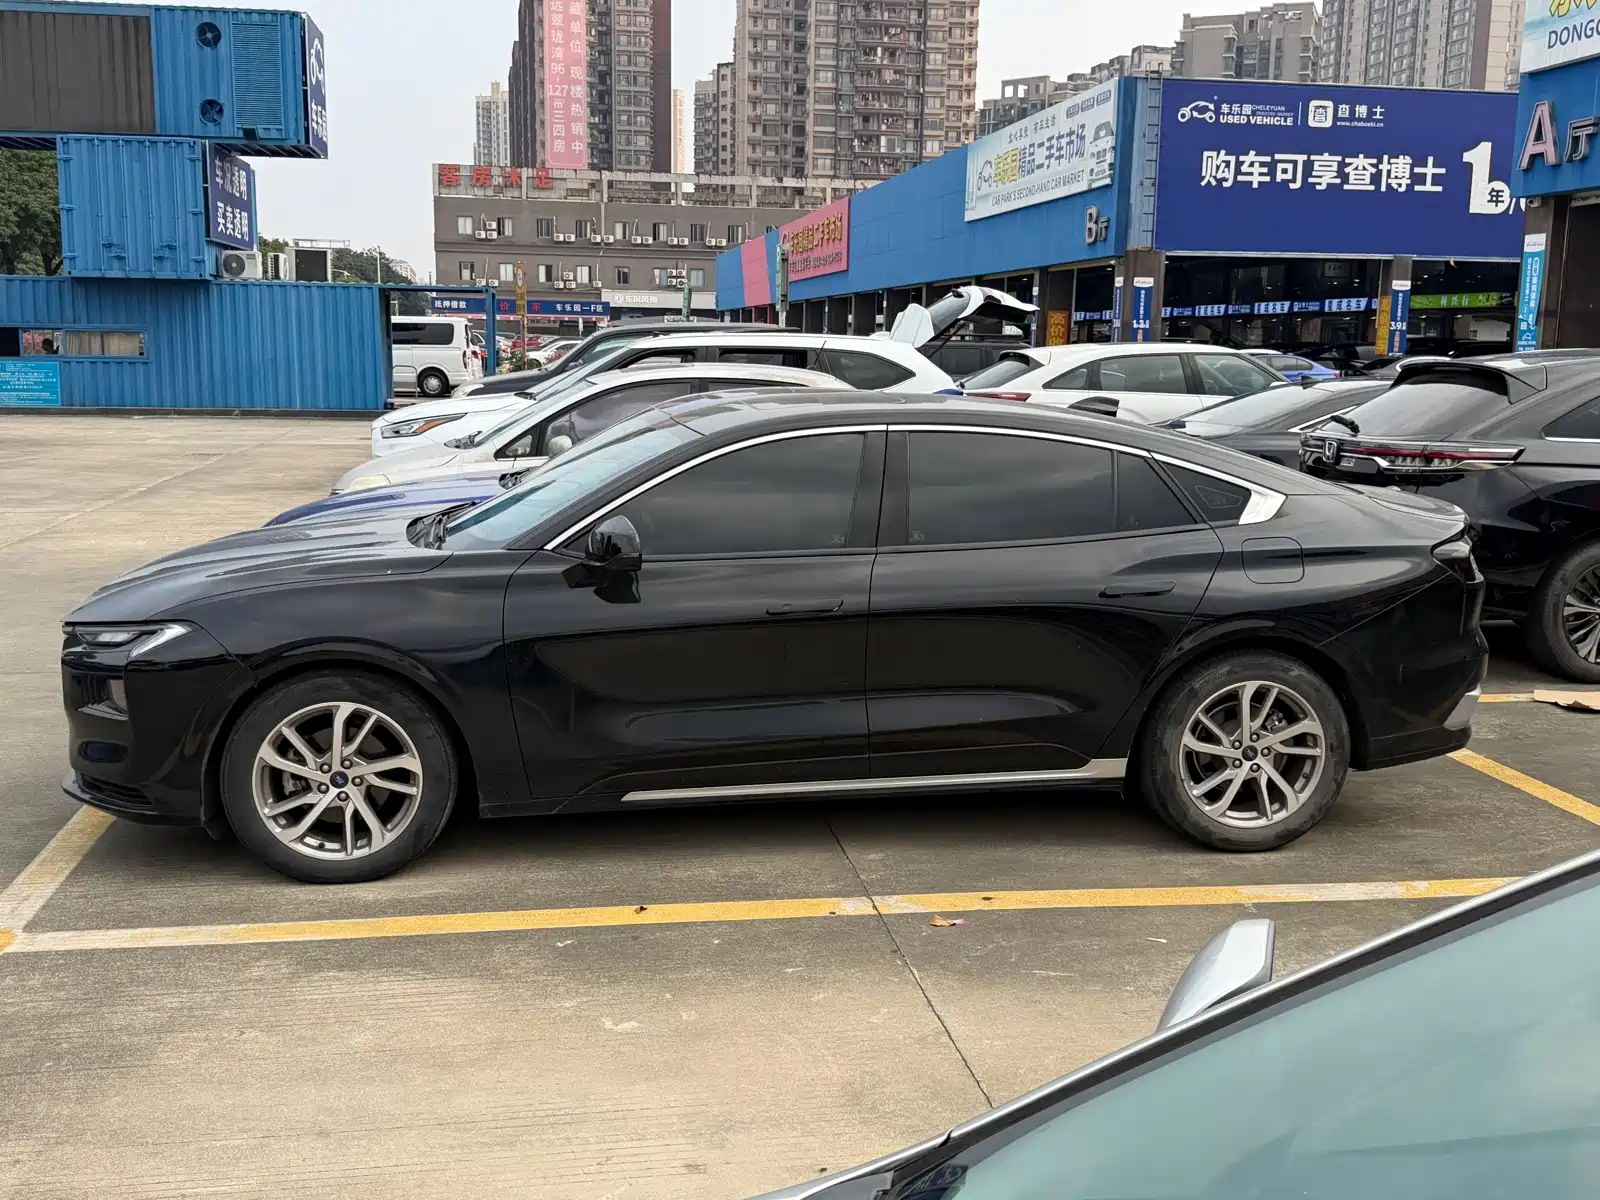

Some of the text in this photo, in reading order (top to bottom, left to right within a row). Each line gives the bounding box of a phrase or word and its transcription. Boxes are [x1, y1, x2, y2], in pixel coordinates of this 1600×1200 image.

[1220, 103, 1252, 115] 车乐园
[1337, 104, 1385, 119] 查博士
[1220, 115, 1294, 126] USED VEHICLE
[214, 156, 247, 201] 车况透明
[1051, 176, 1061, 190] CAR
[1062, 169, 1085, 187] MARKET
[1200, 149, 1447, 193] 购车可享查博士
[216, 201, 249, 242] 买卖透明
[434, 300, 468, 309] 抵押借款
